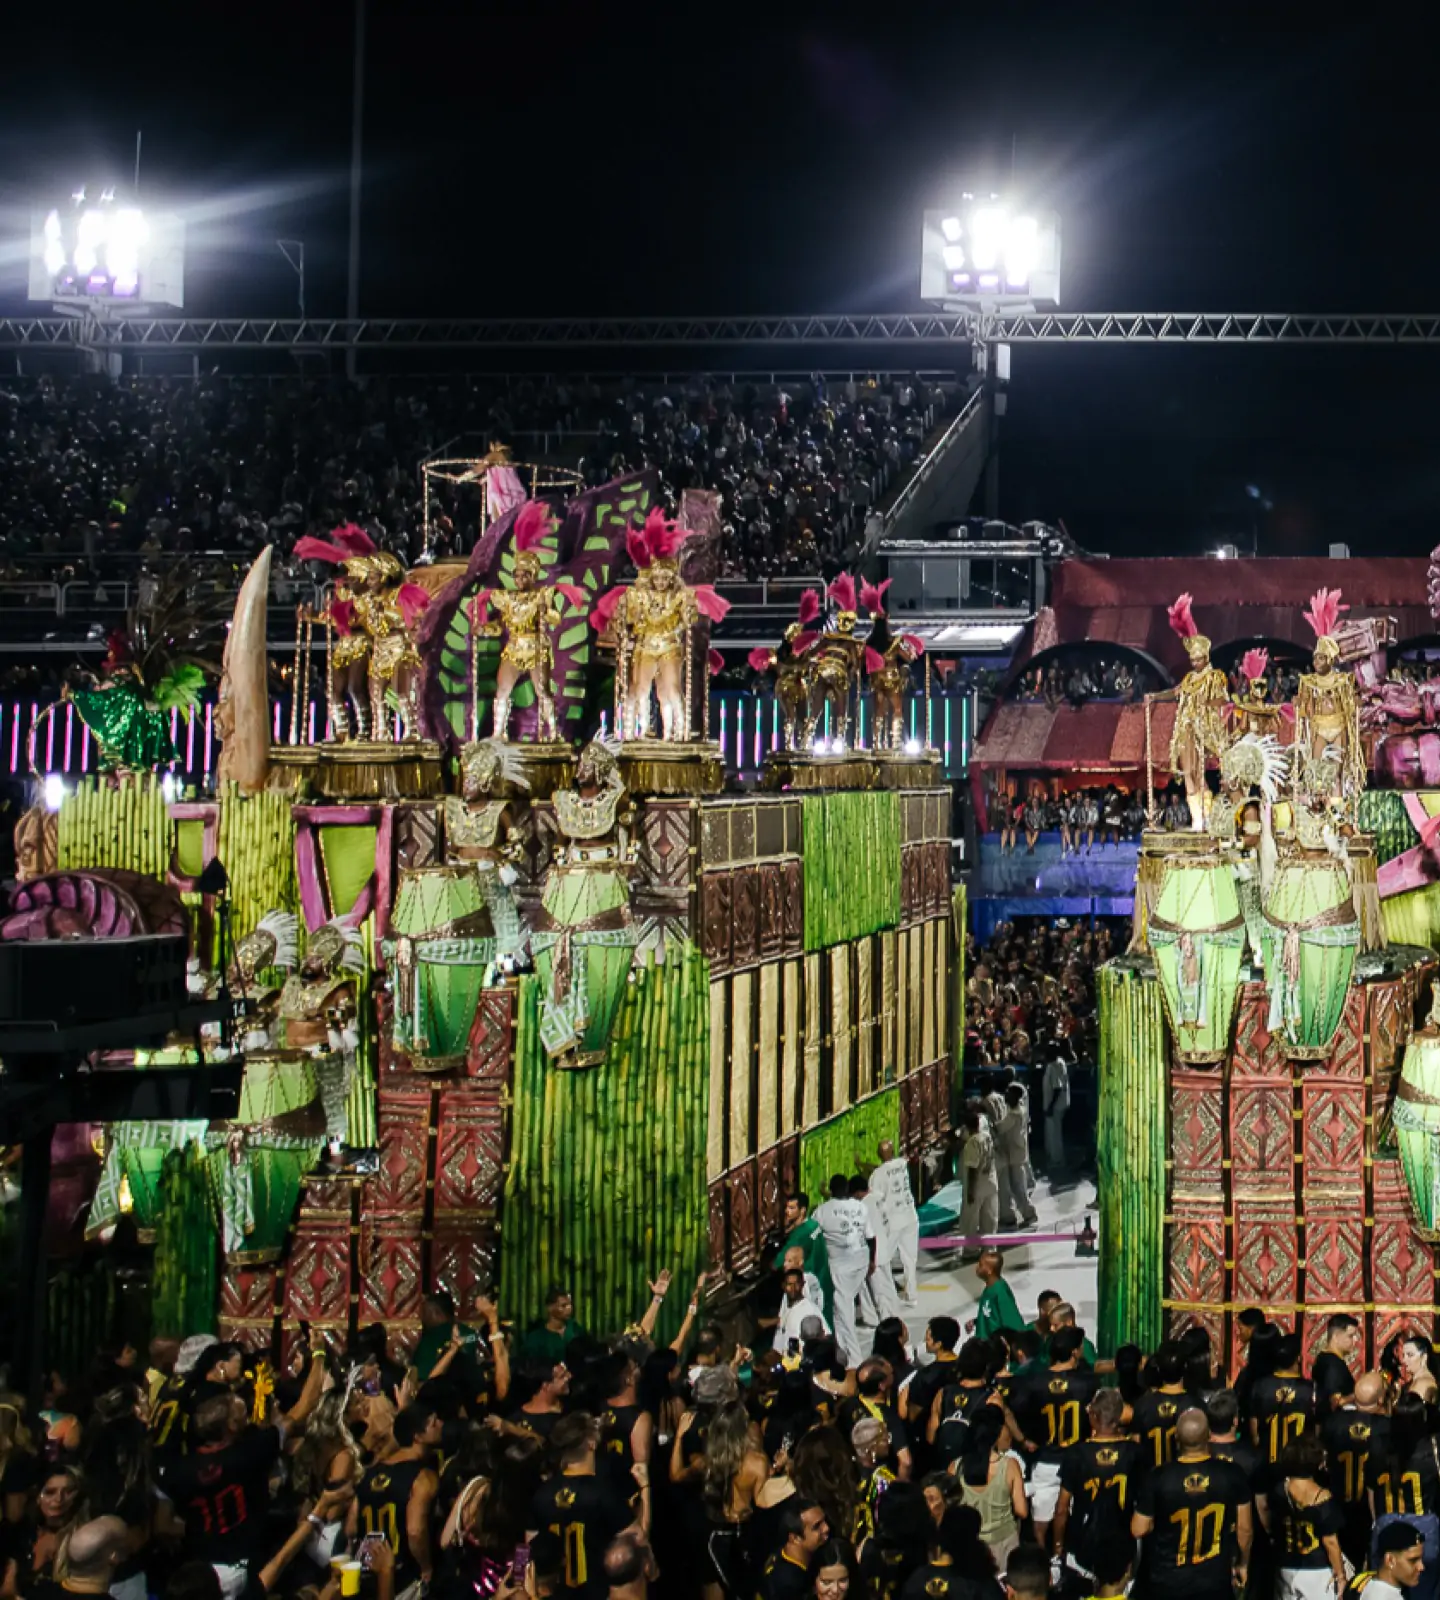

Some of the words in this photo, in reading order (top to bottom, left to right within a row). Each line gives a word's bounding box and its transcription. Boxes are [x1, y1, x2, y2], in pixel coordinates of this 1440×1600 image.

[1041, 1400, 1080, 1449] 10
[189, 1483, 248, 1536] 10
[1169, 1502, 1226, 1567] 10
[548, 1520, 588, 1589] 0
